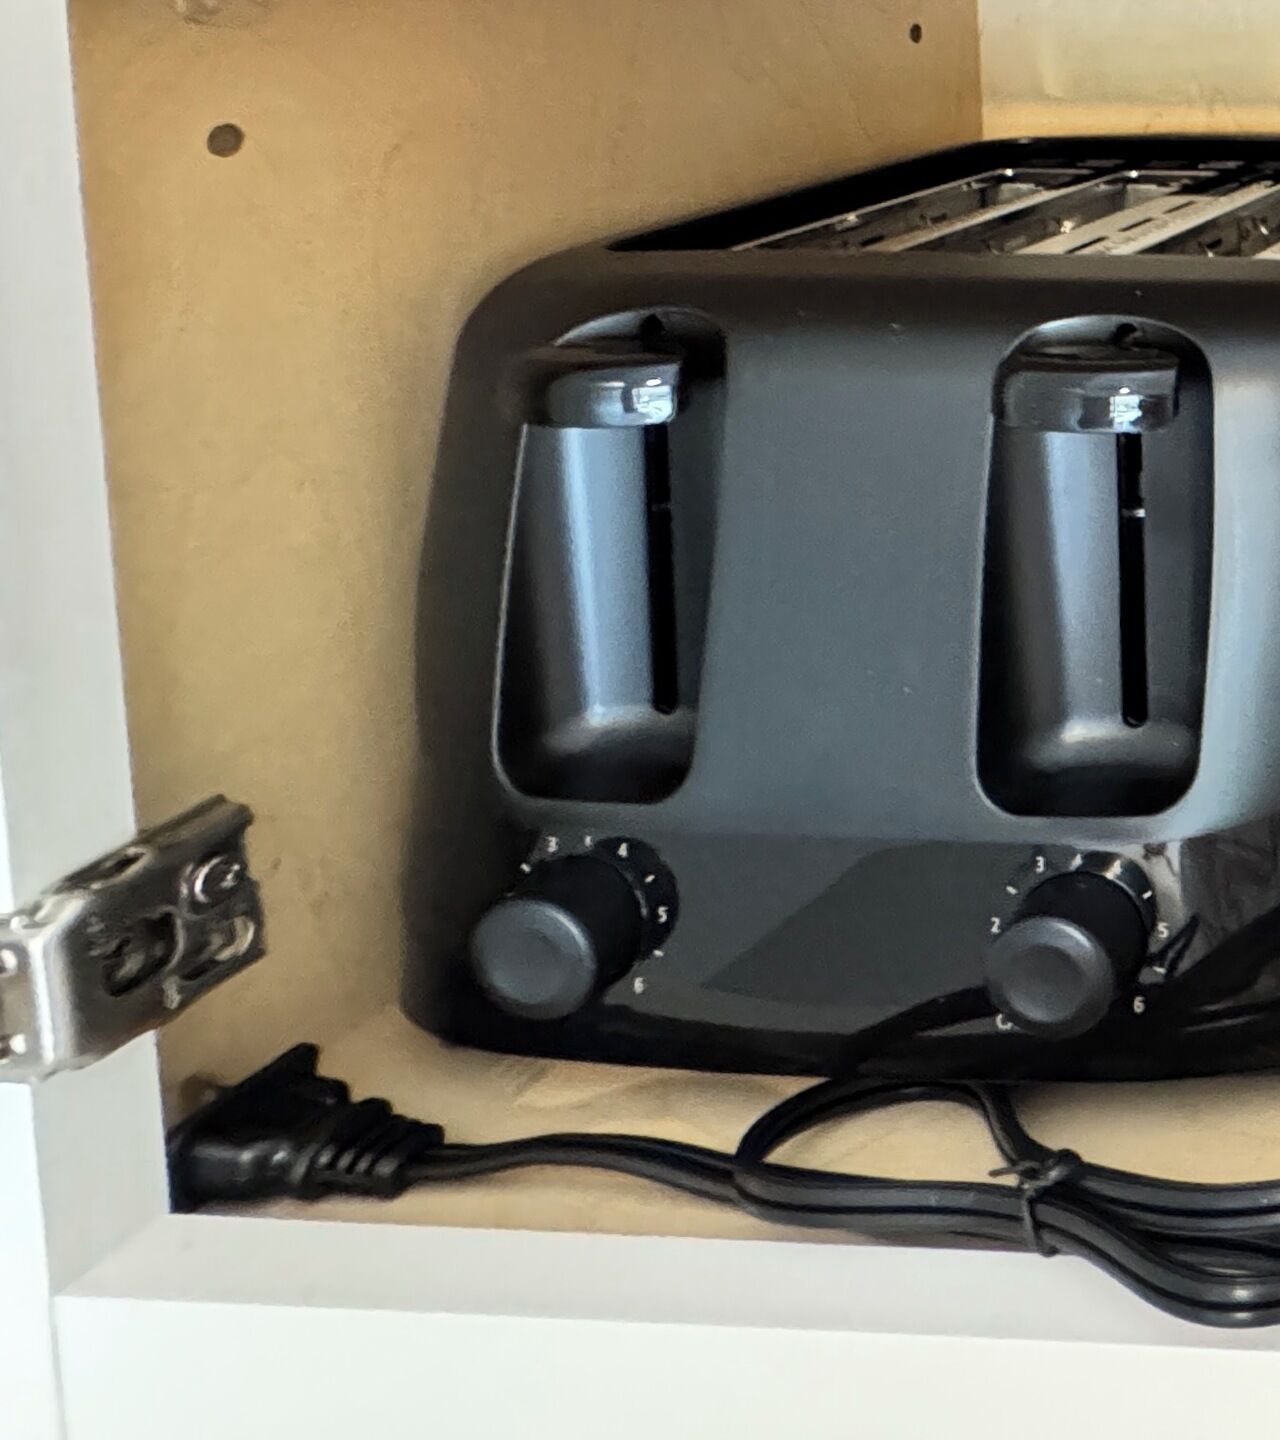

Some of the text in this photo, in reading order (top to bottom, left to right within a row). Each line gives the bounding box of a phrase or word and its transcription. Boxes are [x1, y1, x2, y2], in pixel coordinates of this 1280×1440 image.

[546, 835, 559, 852] 3
[618, 843, 628, 858] 4
[1035, 856, 1046, 873] 3
[658, 906, 668, 923] 5
[990, 917, 1001, 934] 2
[1157, 922, 1169, 938] 5
[633, 977, 645, 994] 6
[1134, 996, 1146, 1013] 6
